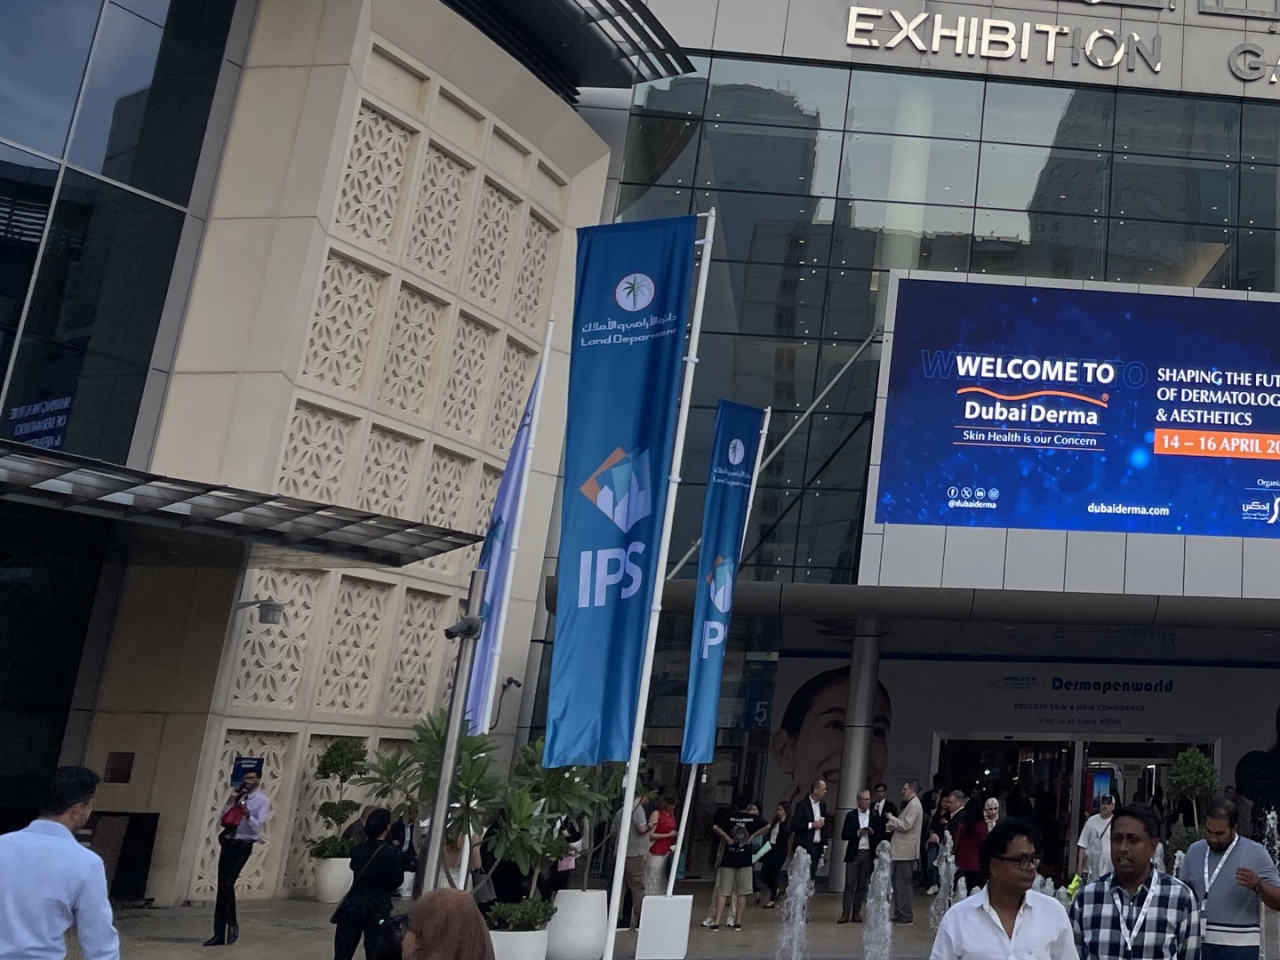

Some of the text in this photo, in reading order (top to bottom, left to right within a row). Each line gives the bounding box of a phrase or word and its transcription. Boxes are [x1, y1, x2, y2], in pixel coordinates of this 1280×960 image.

[845, 5, 1162, 74] EXHIBITION
[580, 328, 677, 347] Land Department
[956, 355, 1115, 384] WELCOME TO
[1157, 367, 1223, 386] SHAPING
[1224, 371, 1252, 387] THE
[1156, 387, 1178, 402] OF
[964, 401, 1099, 425] Dubai Derma
[1155, 408, 1253, 426] & AESTHETICS
[962, 430, 1097, 446] Skin Health is our Concern
[1162, 434, 1180, 449] 14
[1199, 436, 1217, 451] 16
[1219, 437, 1263, 454] APRIL
[947, 499, 997, 509] @dubaiderma
[1087, 502, 1170, 516] dubaiderma.com
[577, 540, 647, 609] IPS
[1051, 676, 1174, 694] Dermapenworld
[1050, 703, 1068, 711] SKIN
[1097, 704, 1146, 712] CONFIDENCE
